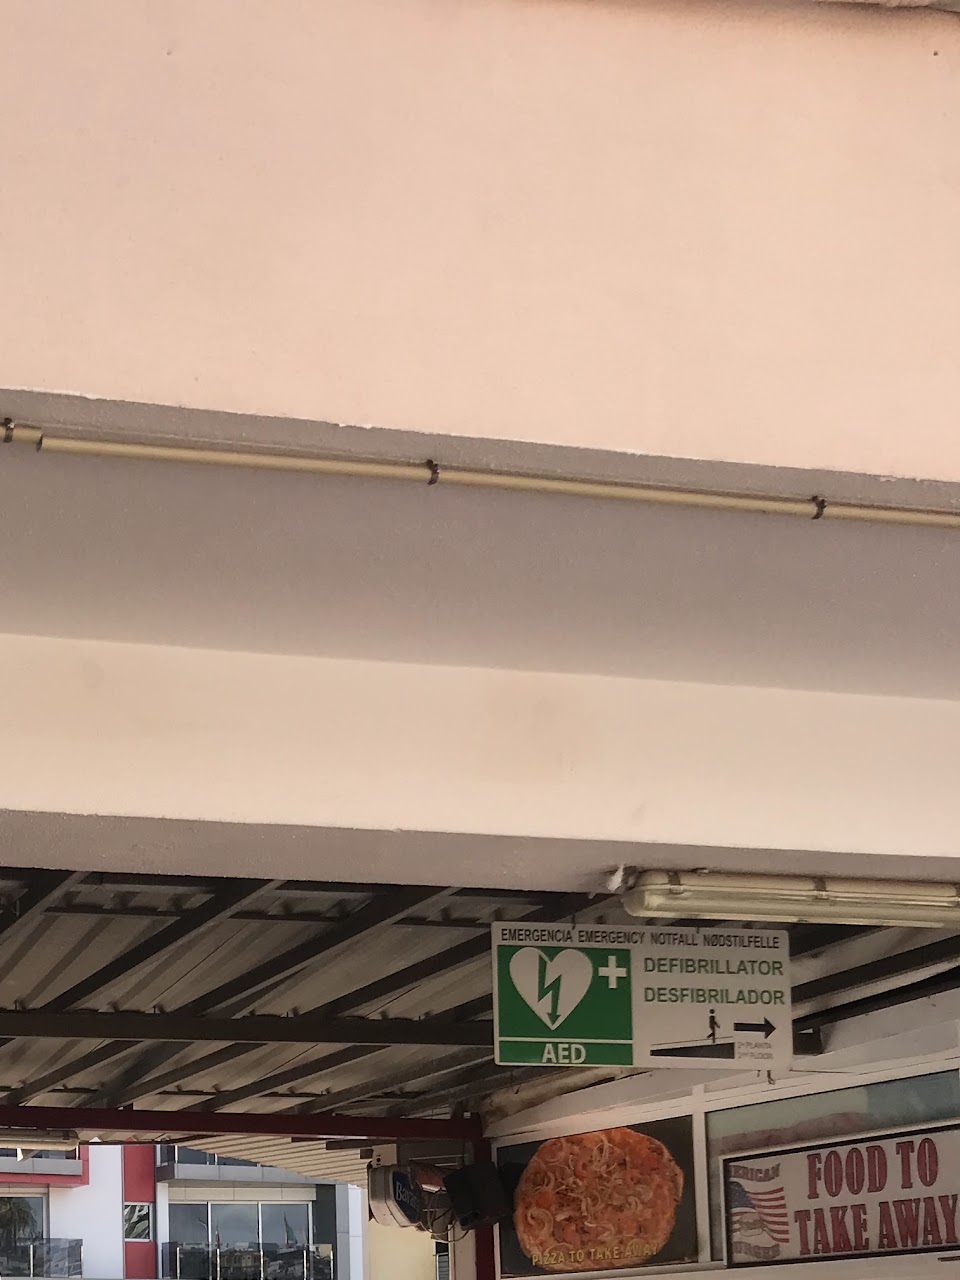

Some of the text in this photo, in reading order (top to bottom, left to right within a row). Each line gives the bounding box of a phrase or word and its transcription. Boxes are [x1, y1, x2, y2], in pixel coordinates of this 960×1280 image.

[501, 928, 780, 949] EMERGENCIA EMERGENCY NOTFALL NØDSTILFELLE
[644, 957, 784, 976] DEFIBRILLATOR
[644, 987, 785, 1005] DESFIBRILADOR
[541, 1044, 587, 1064] AED
[807, 1137, 939, 1199] FOOD TO
[794, 1193, 959, 1256] TAKE AWAY
[532, 1243, 658, 1266] PIZZA TO TAKE AWAY
